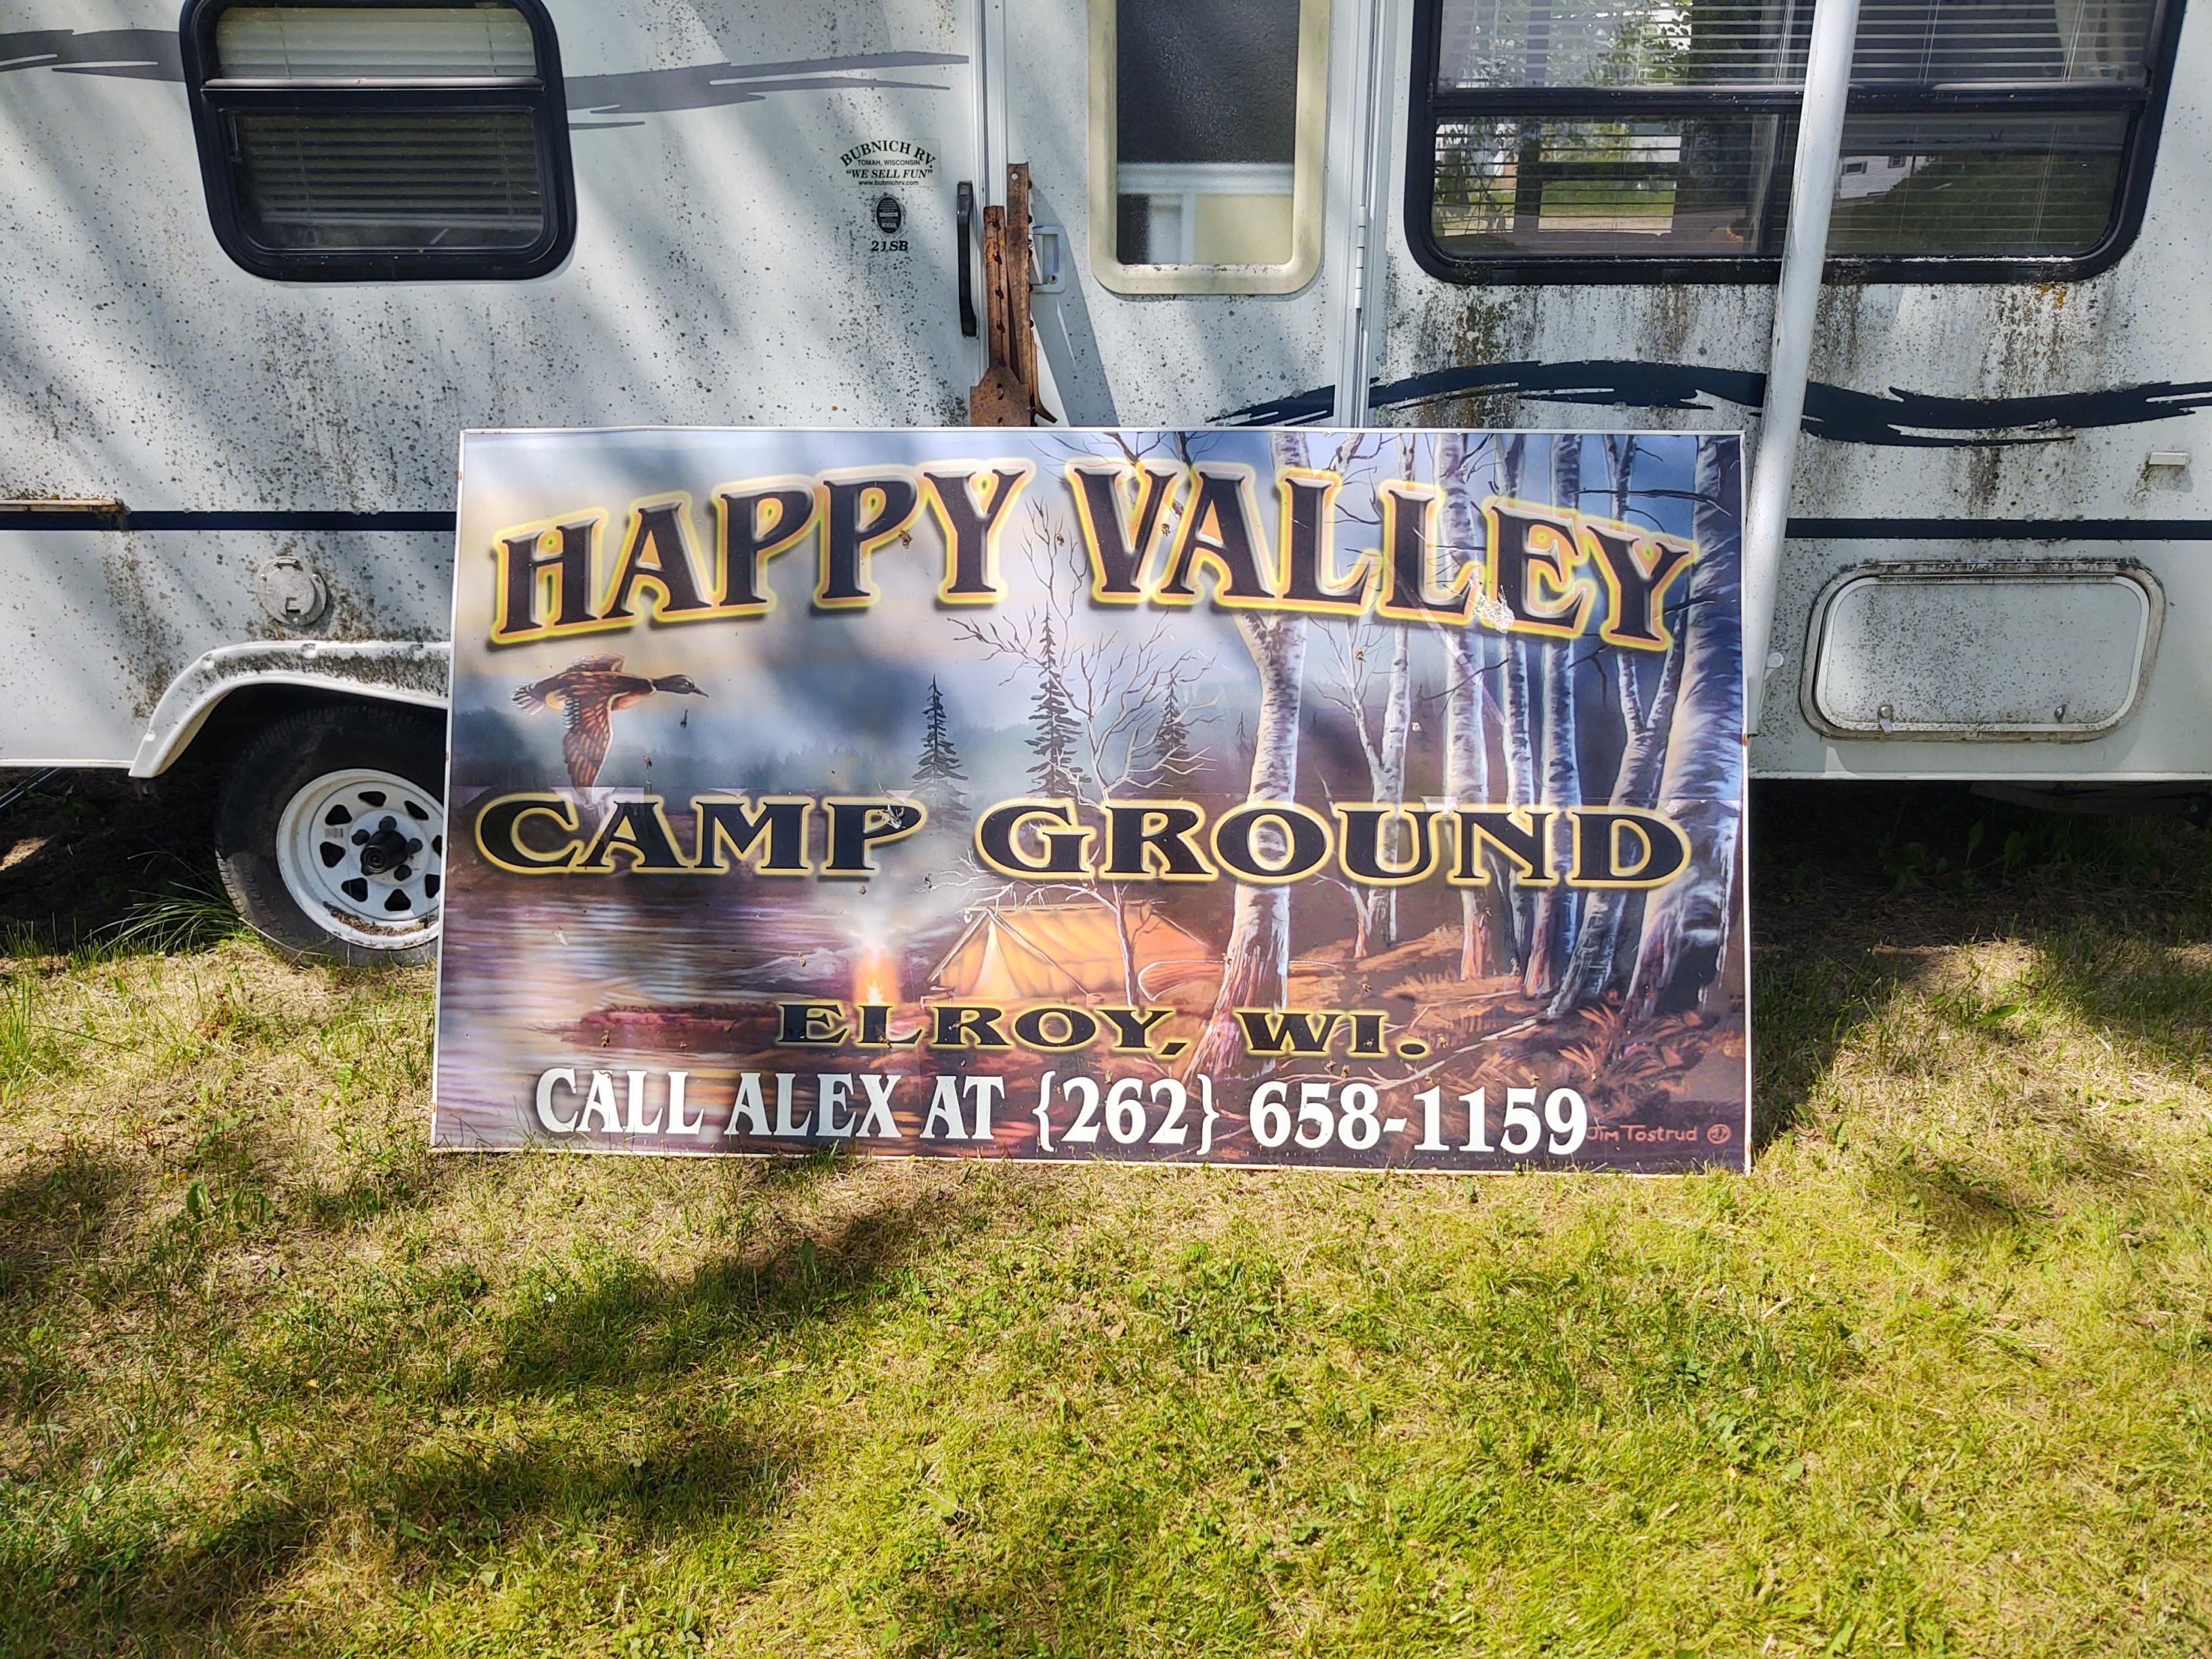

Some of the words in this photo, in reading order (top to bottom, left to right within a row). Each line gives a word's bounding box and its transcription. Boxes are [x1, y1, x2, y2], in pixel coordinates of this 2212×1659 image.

[840, 140, 912, 167] BUBNICH
[871, 169, 901, 179] SELL
[871, 241, 909, 251] 21SB
[493, 464, 1030, 640] HAPPY
[1068, 464, 1694, 647] VALLEY
[476, 795, 926, 874] CAMP
[977, 802, 1688, 885] GROUND
[777, 1000, 1190, 1056] ELROY,
[1237, 1008, 1430, 1058] WI.
[535, 1067, 704, 1136] CALL
[724, 1071, 902, 1139] ALEX
[920, 1075, 1005, 1139] AT
[1032, 1070, 1221, 1156] {262}
[1249, 1081, 1588, 1155] 658-1159
[1620, 1124, 1698, 1143] Tostrud
